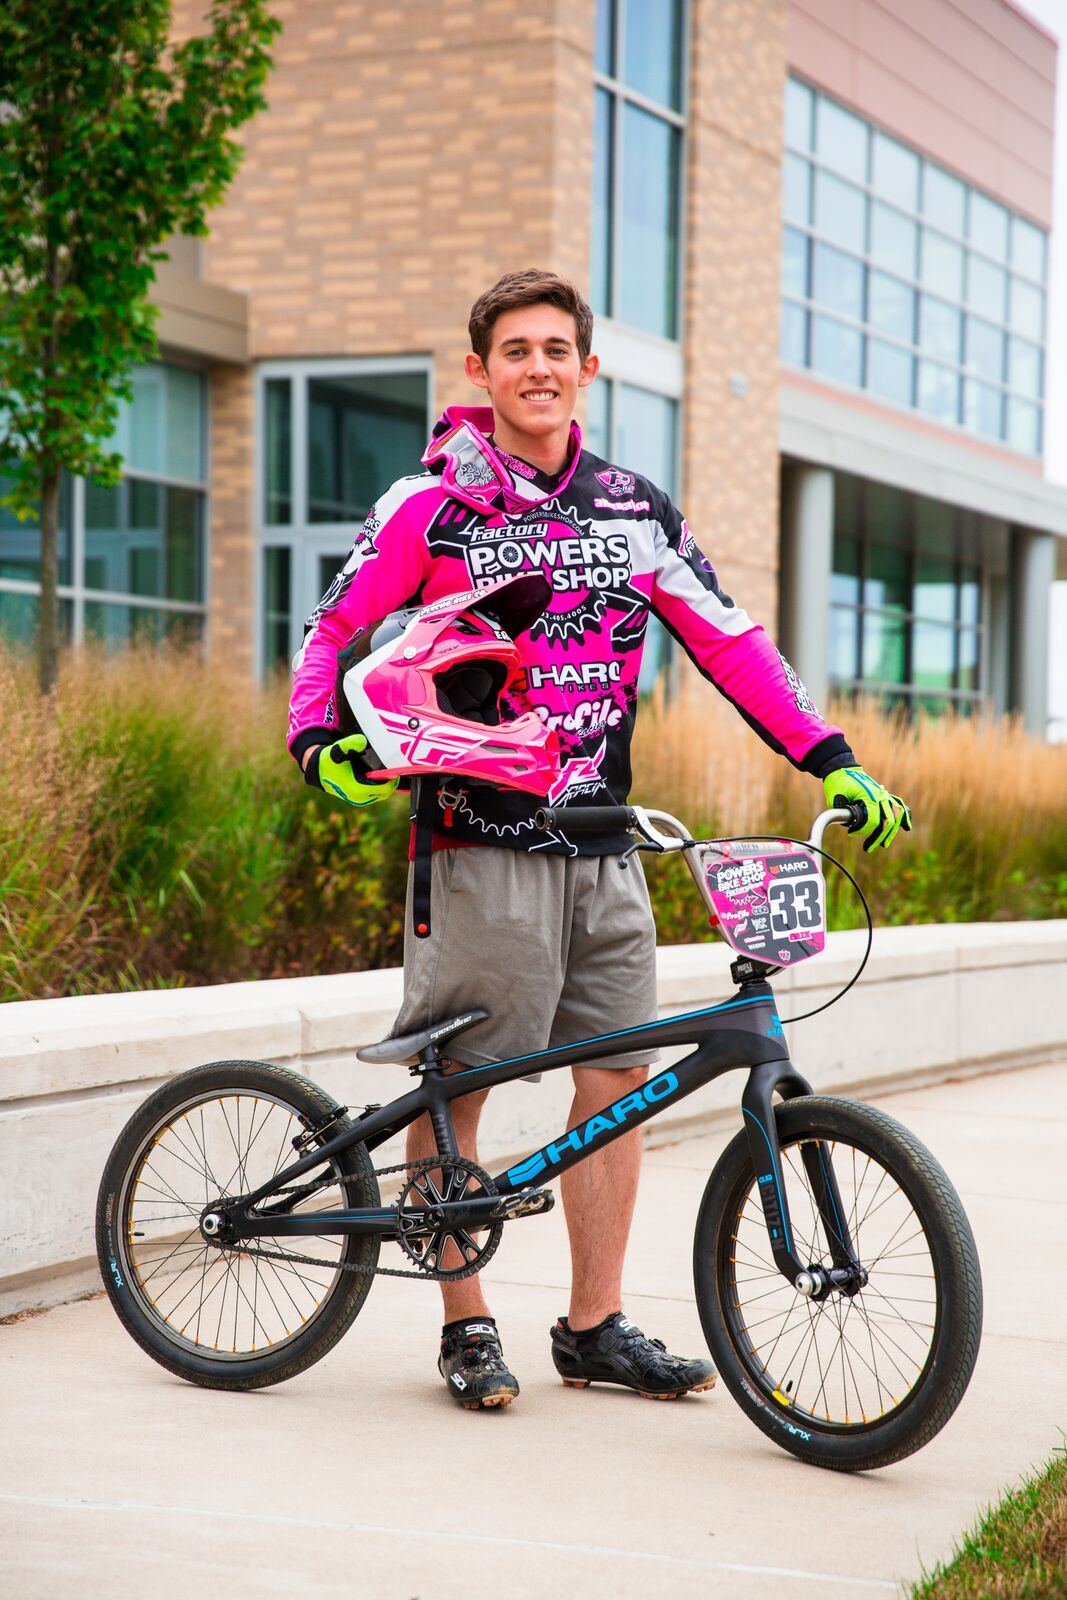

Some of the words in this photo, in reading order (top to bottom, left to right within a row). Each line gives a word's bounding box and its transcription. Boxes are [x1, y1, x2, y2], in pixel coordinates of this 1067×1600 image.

[470, 523, 549, 542] Factory
[469, 536, 630, 576] POWERS
[552, 567, 630, 591] SHOP
[717, 861, 764, 884] POWERS
[779, 861, 808, 873] HARO
[718, 878, 740, 892] BIKE
[741, 871, 766, 886] SHOP
[769, 880, 822, 933] 33
[430, 1015, 472, 1039] speedline
[546, 1071, 679, 1164] HARO
[465, 1324, 494, 1336] SIDI
